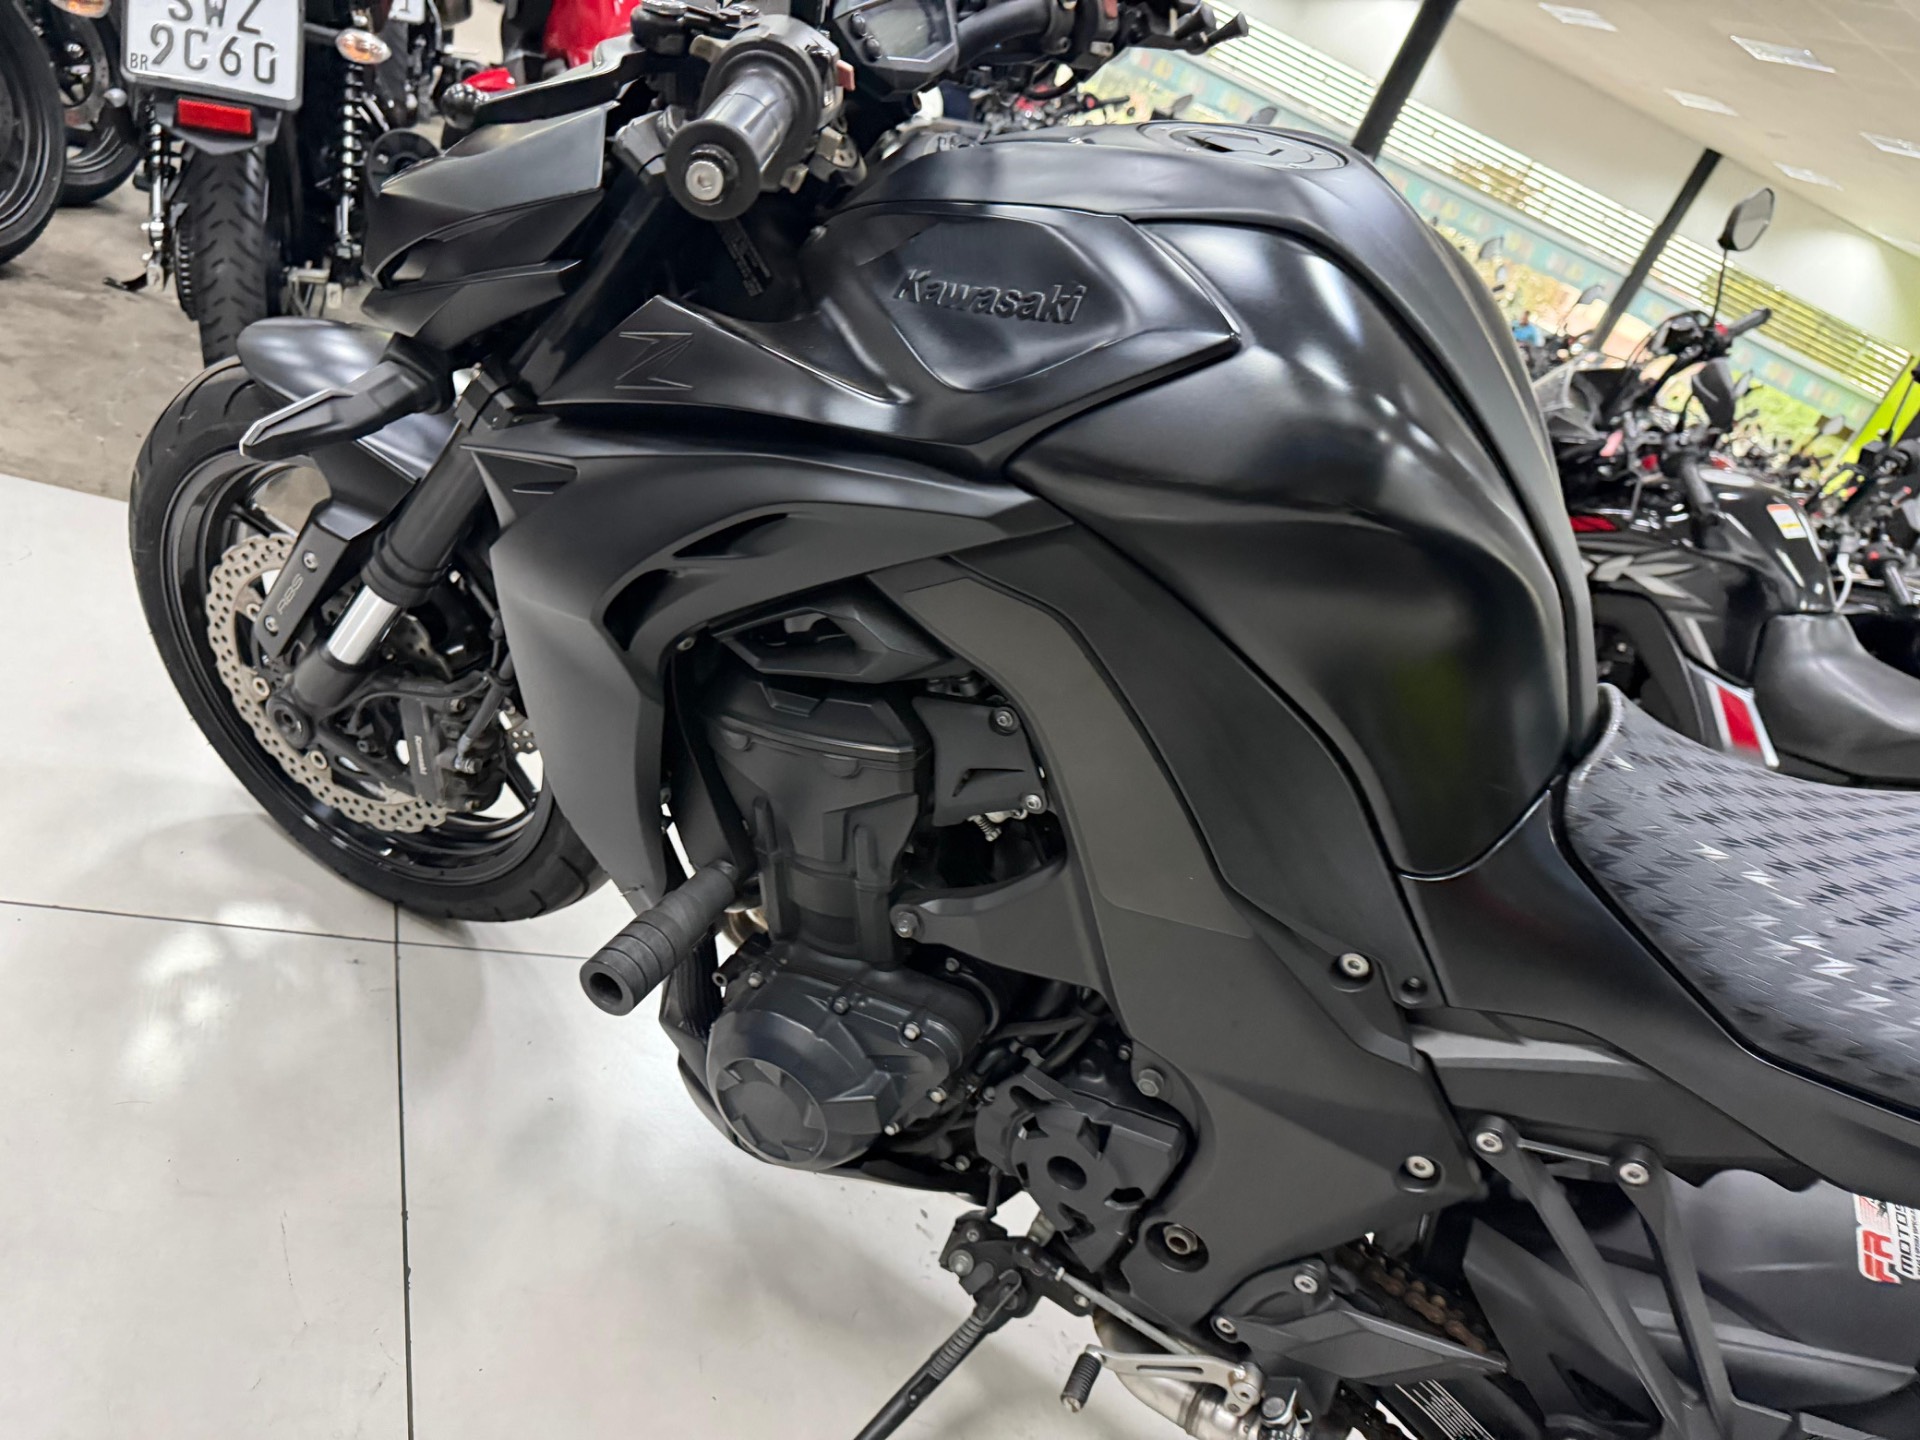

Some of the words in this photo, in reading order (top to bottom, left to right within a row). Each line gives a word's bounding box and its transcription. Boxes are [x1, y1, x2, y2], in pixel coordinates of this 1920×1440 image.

[129, 52, 149, 70] BR
[150, 23, 277, 84] 9C60
[894, 268, 1087, 324] Kawasaki
[276, 573, 304, 615] ABS
